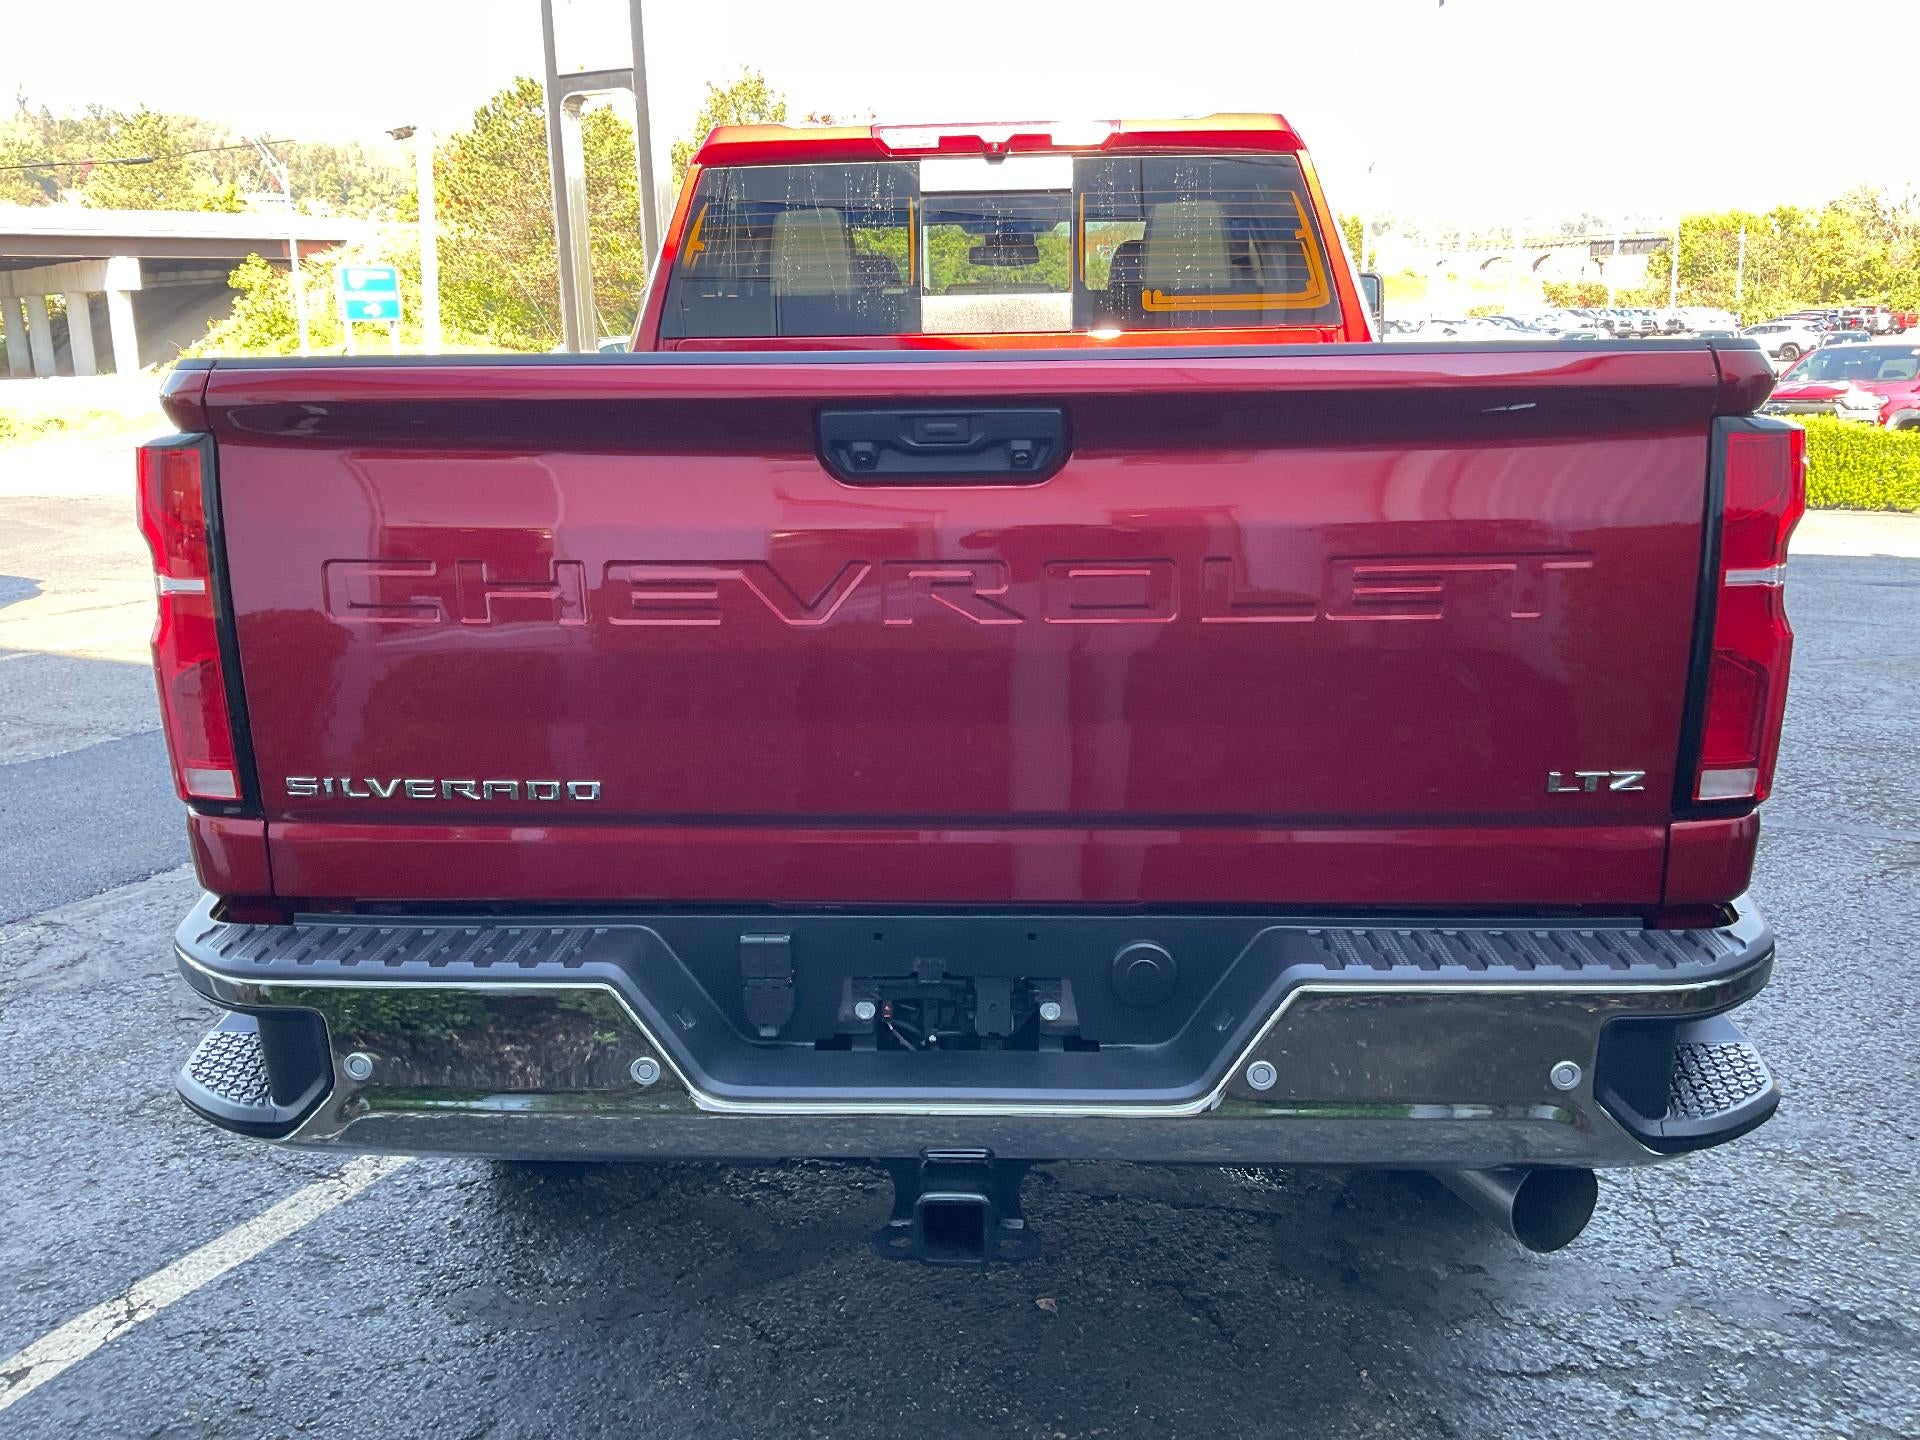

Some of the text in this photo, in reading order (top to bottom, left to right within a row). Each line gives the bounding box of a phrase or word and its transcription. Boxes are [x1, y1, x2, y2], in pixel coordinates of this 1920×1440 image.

[320, 554, 1595, 627] CHEVROLET
[285, 776, 601, 801] SILVERADO
[1547, 770, 1646, 793] LTZ
